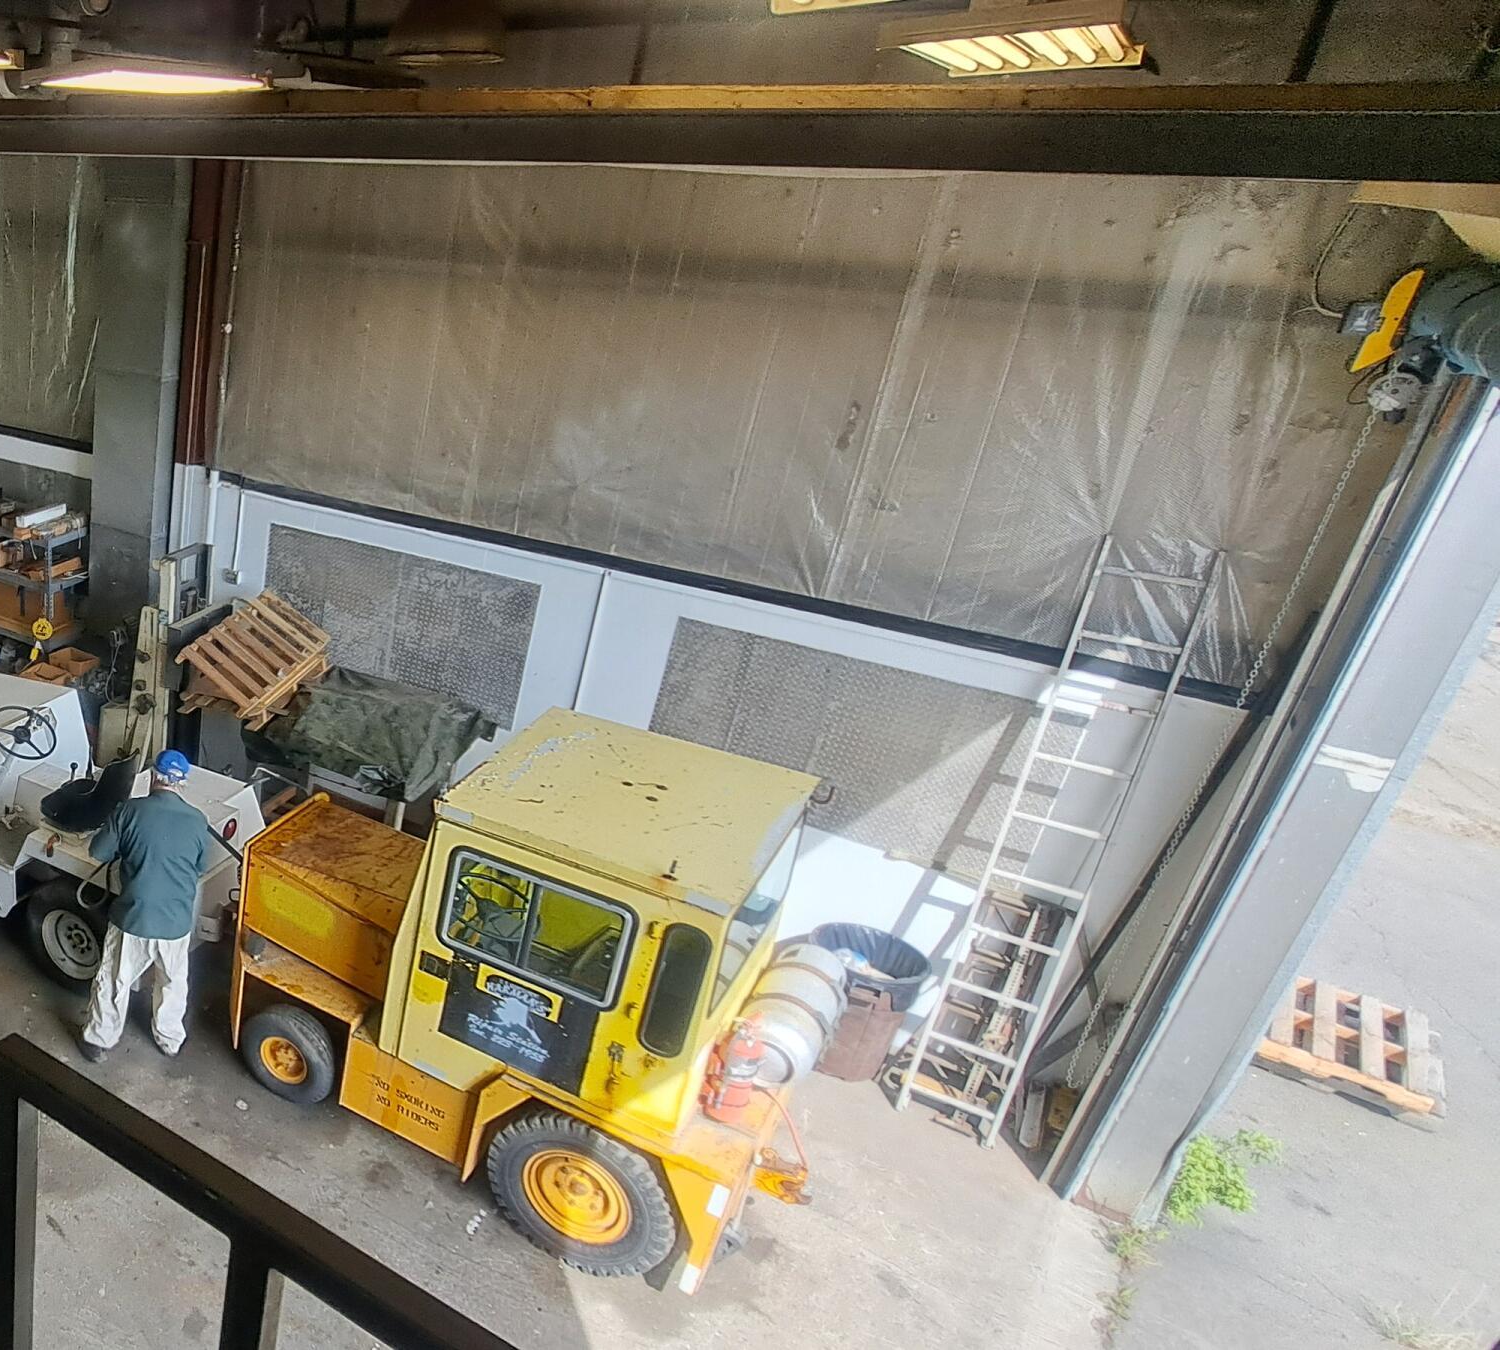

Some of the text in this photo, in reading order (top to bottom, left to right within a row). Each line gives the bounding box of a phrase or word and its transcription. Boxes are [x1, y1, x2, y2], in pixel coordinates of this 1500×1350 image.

[374, 1078, 446, 1120] NO SMOKING
[376, 1093, 440, 1132] NO RIDERS
